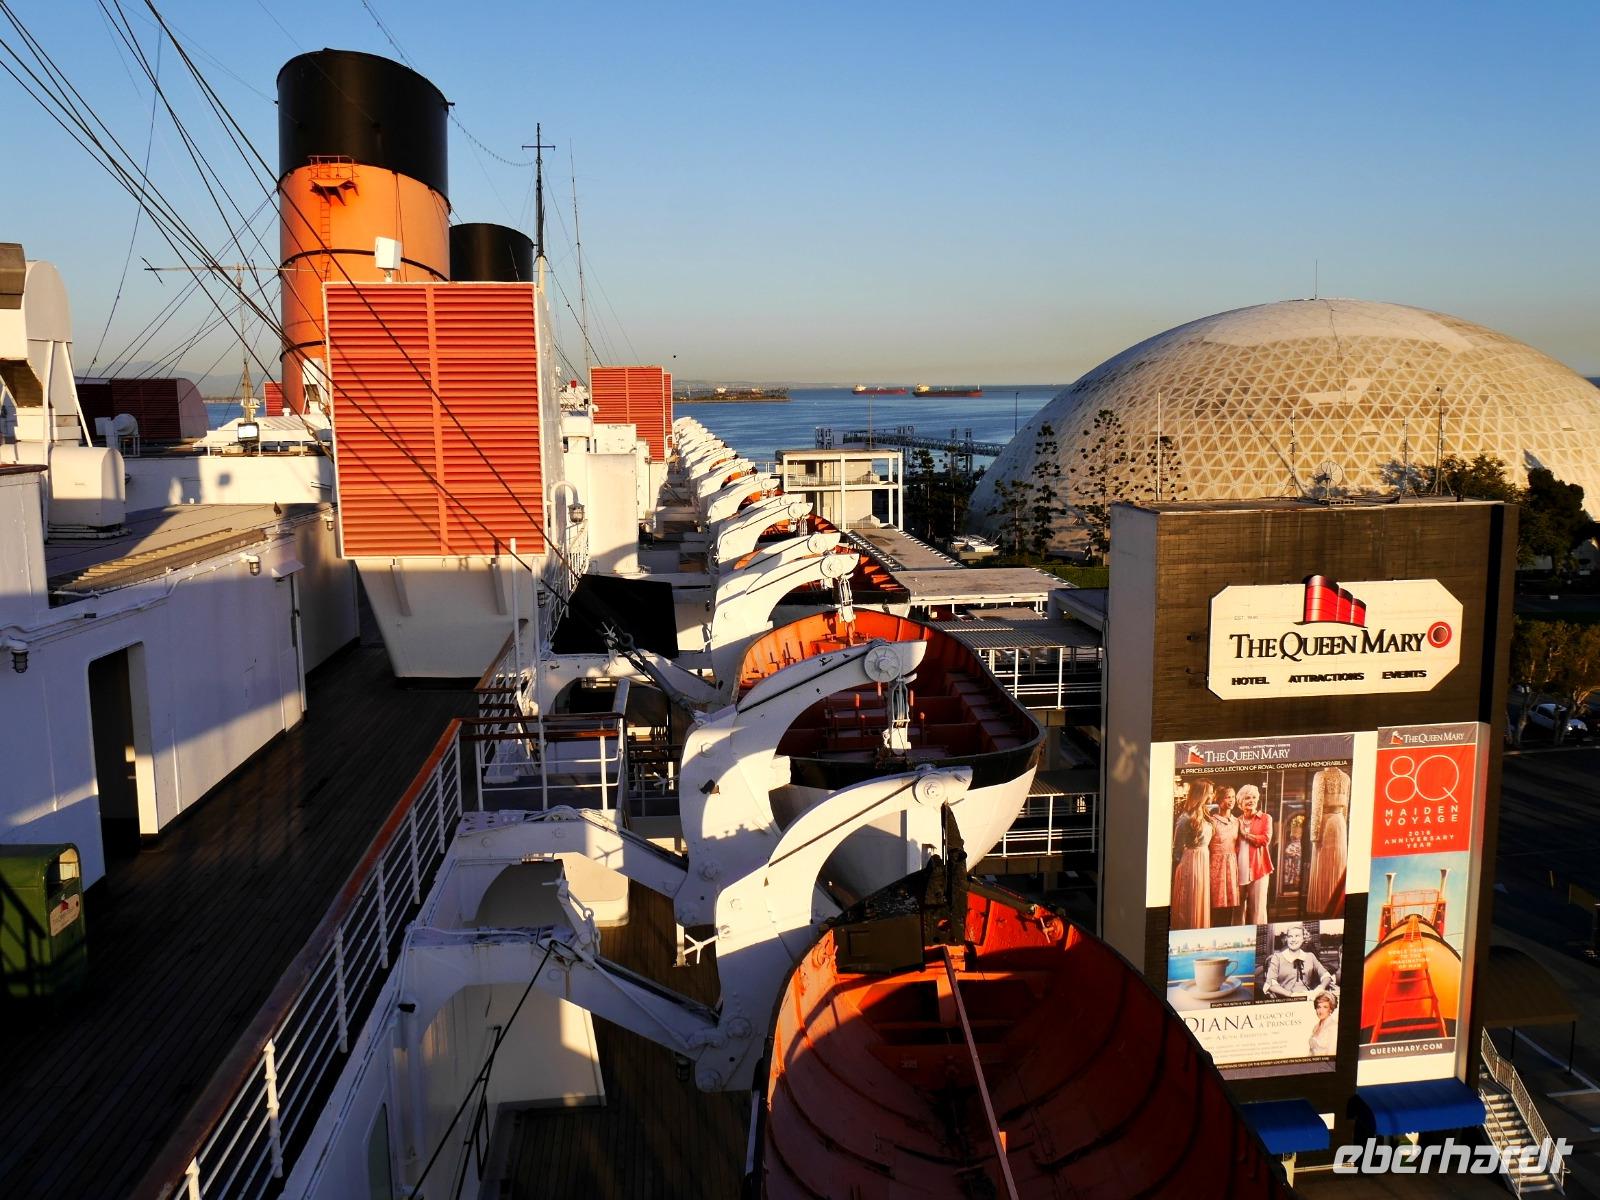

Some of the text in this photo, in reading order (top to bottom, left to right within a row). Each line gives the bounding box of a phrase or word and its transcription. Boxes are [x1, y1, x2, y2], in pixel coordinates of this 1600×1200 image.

[1229, 629, 1426, 662] THE QUEEN MARY
[1231, 669, 1427, 686] HOTEL ATTRACTIONS EVENTS
[1403, 732, 1464, 743] THE QUEEN MARY
[1204, 750, 1226, 762] THE
[1226, 749, 1260, 763] QUEEN
[1261, 747, 1290, 760] MARY
[1215, 765, 1249, 773] COLLECTION
[1385, 805, 1458, 817] MAIDEN
[1385, 814, 1458, 826] VOYAGE
[1384, 834, 1455, 845] ANNIVERSARY
[1370, 1043, 1443, 1055] QUEENMARY.COM
